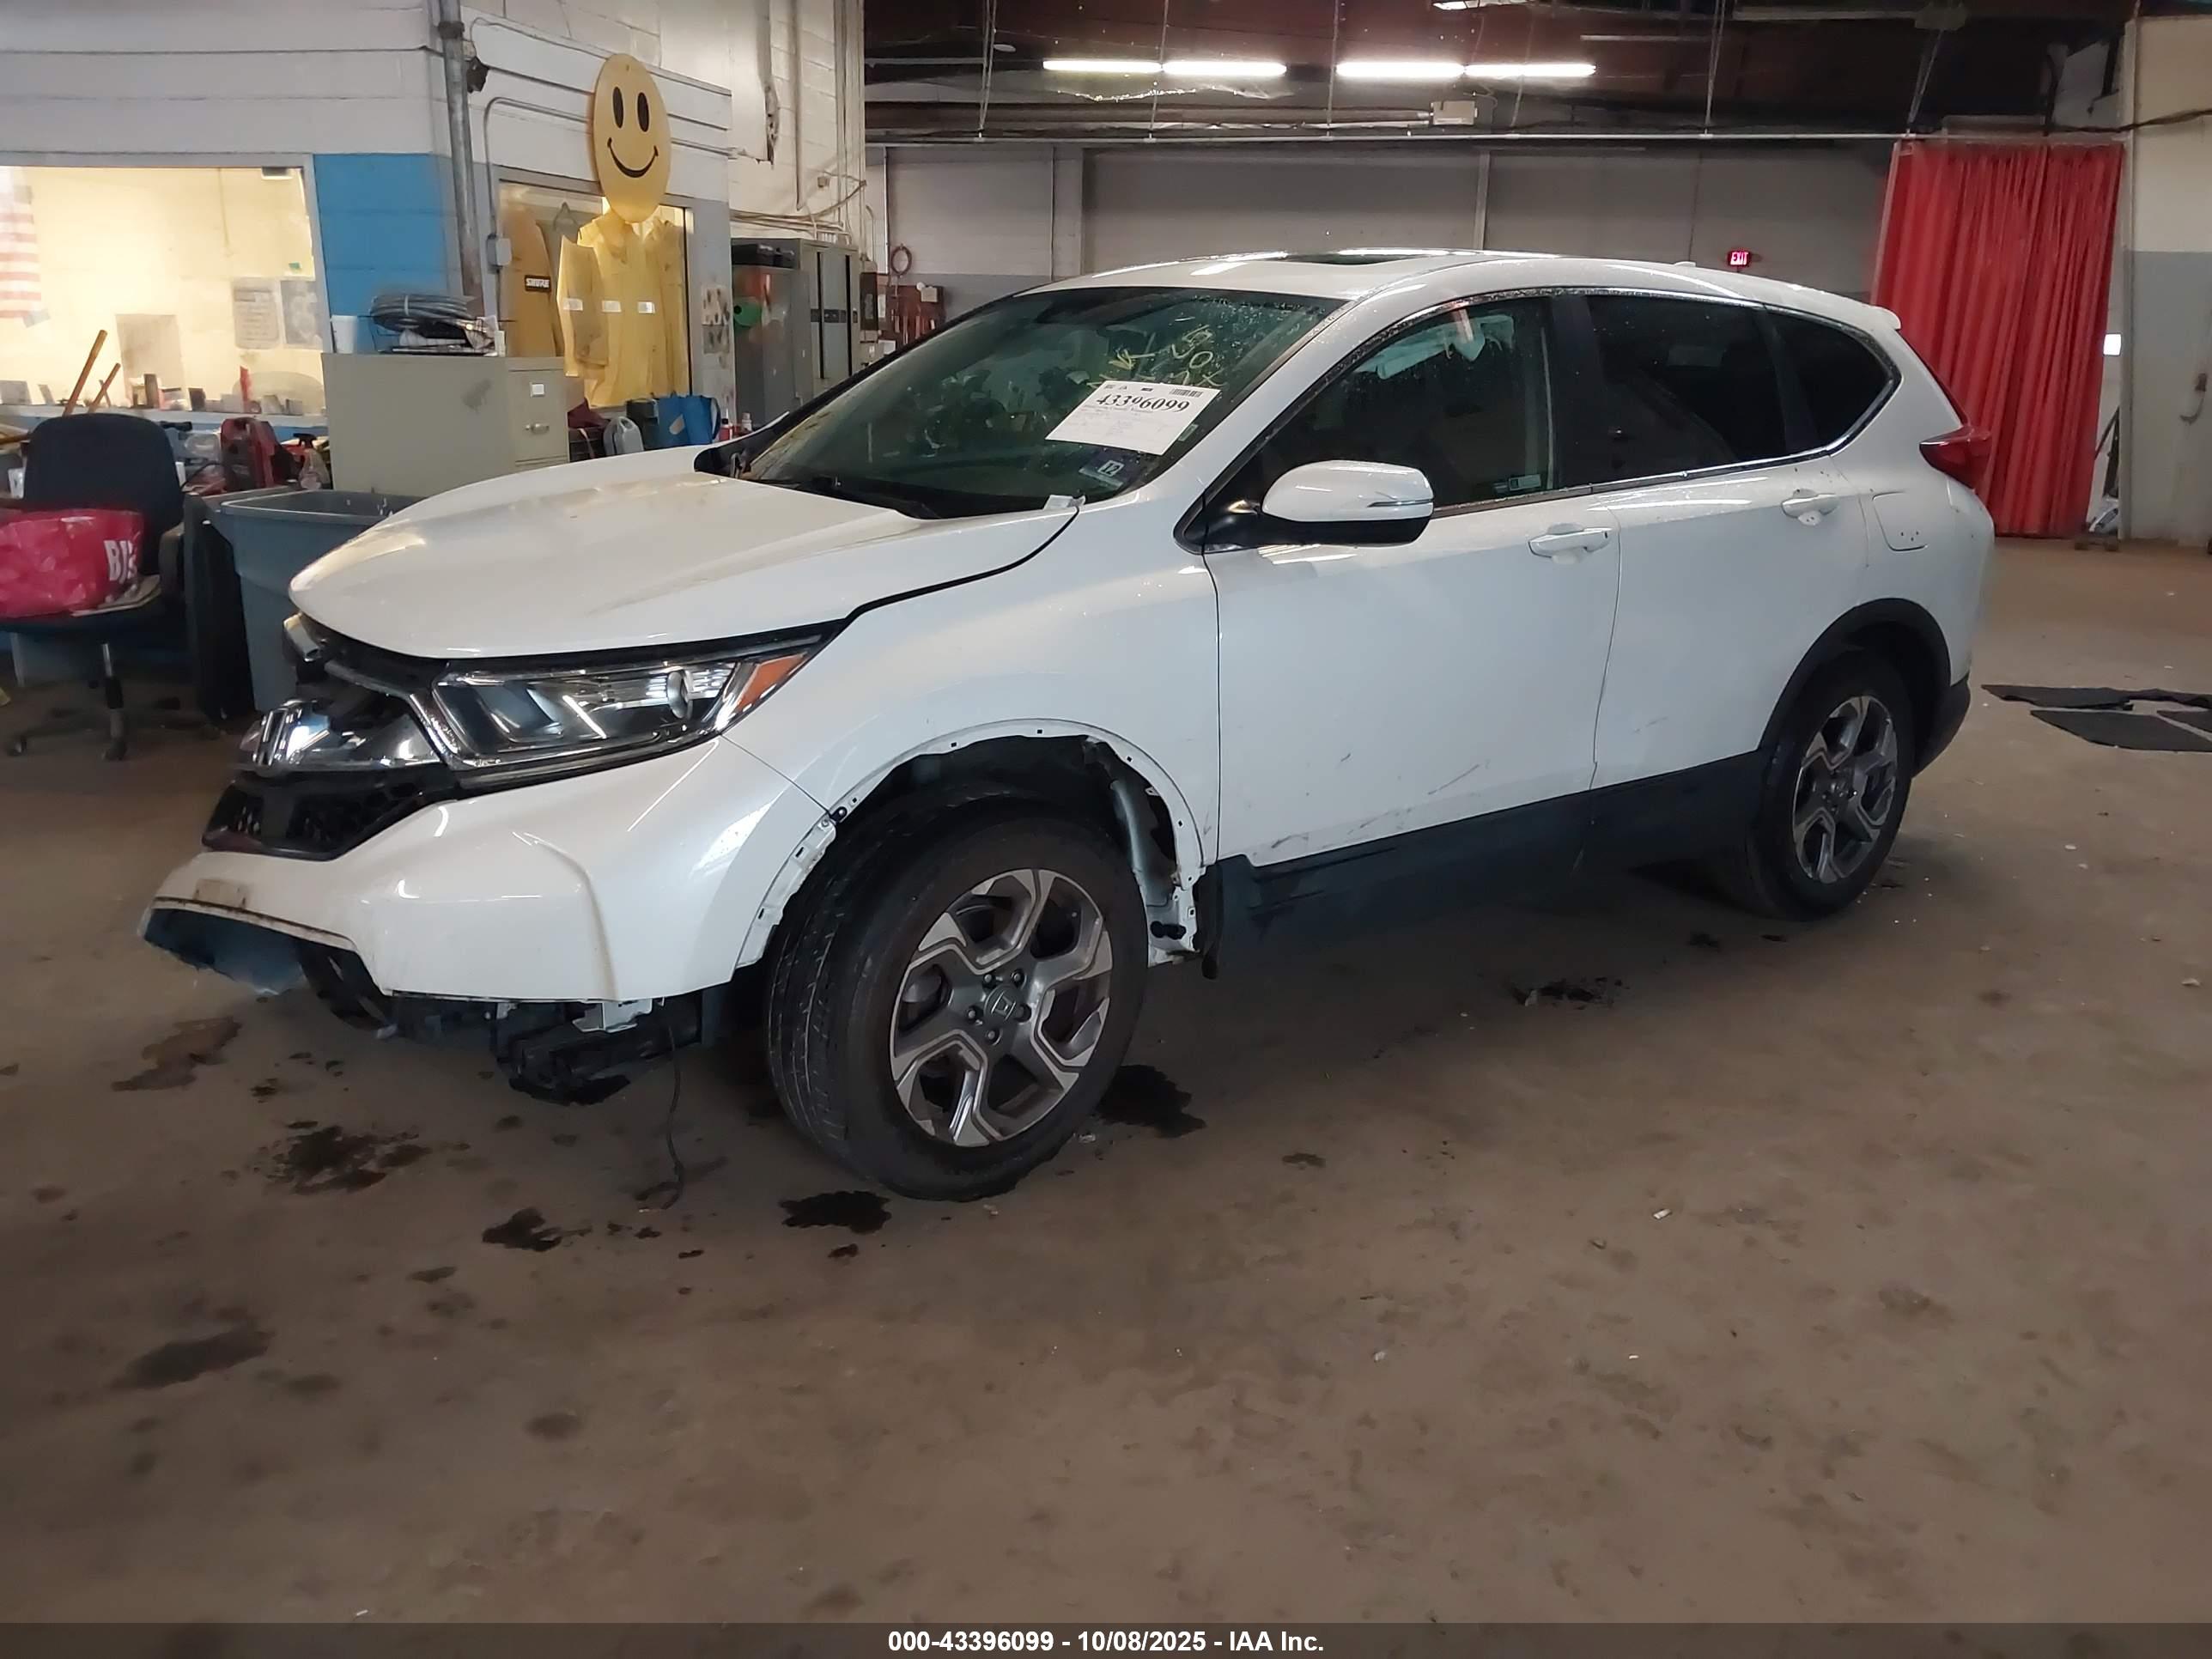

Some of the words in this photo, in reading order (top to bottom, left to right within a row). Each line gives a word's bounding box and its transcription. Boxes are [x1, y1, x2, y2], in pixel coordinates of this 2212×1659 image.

[1730, 251, 1749, 265] EXIT
[526, 277, 550, 289] SHURE
[1096, 393, 1190, 413] 43396099
